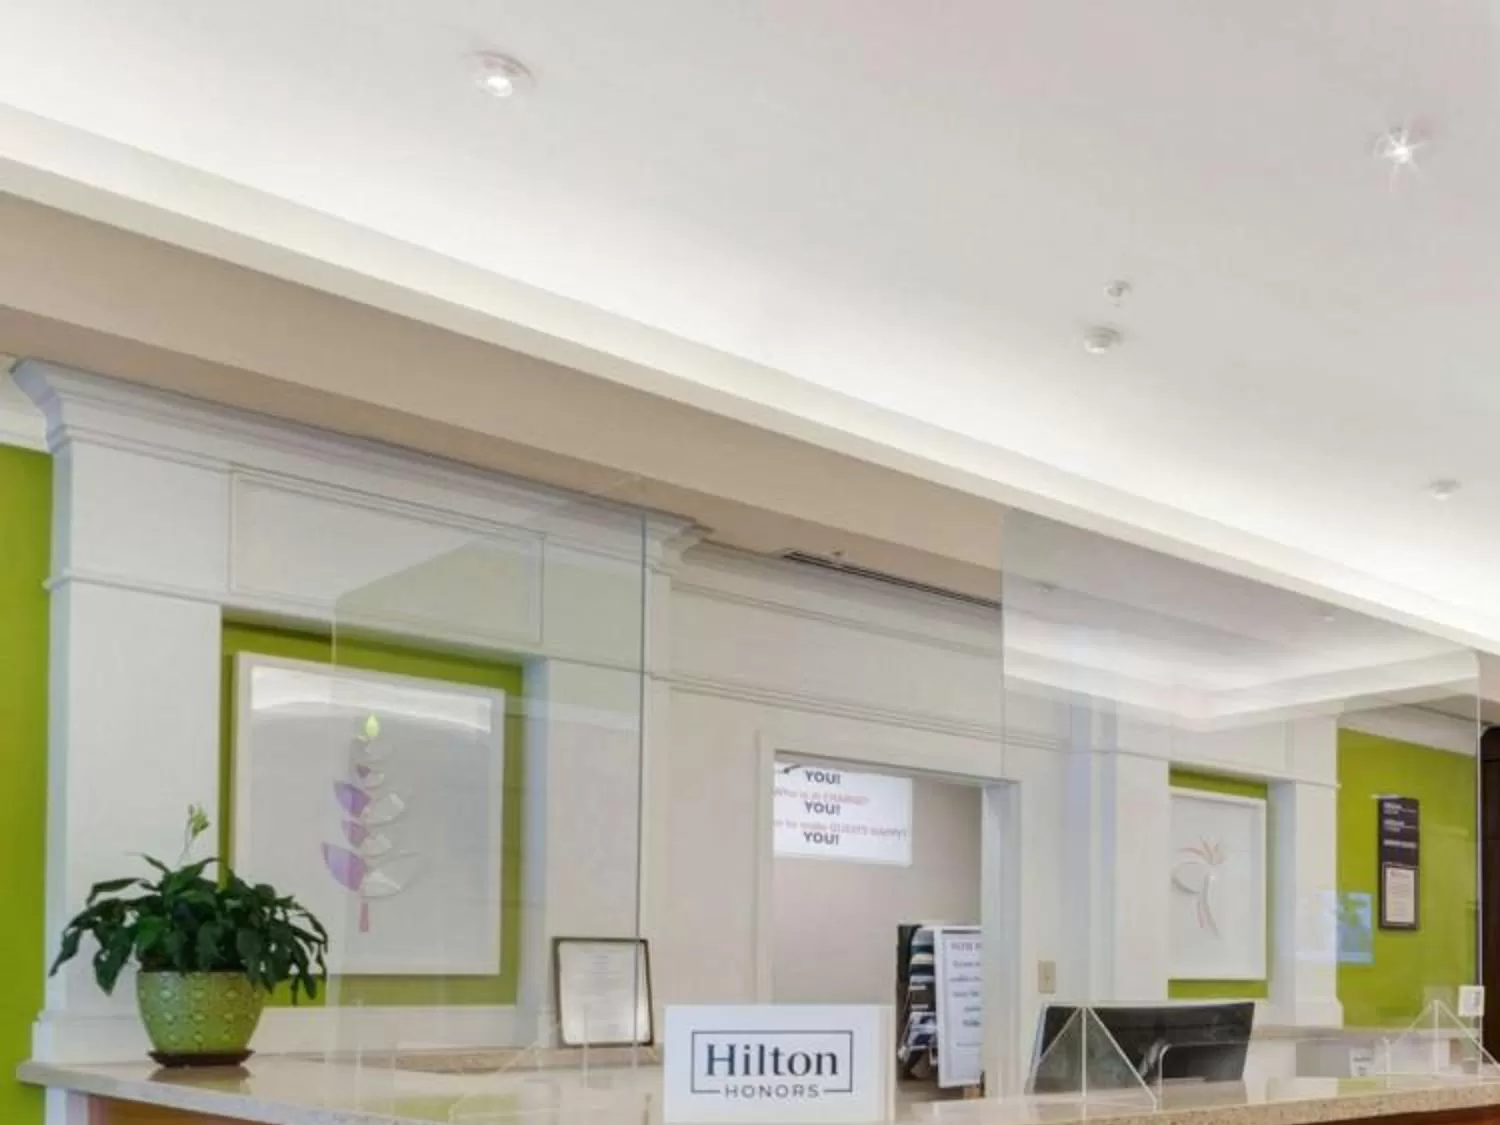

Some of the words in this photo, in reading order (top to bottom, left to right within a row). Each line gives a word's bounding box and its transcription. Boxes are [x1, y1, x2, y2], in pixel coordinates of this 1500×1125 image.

[804, 770, 841, 784] YOU!
[804, 800, 841, 816] YOU!
[803, 831, 839, 845] YOU!
[706, 1043, 838, 1076] Hilton
[724, 1083, 820, 1098] HONORS
